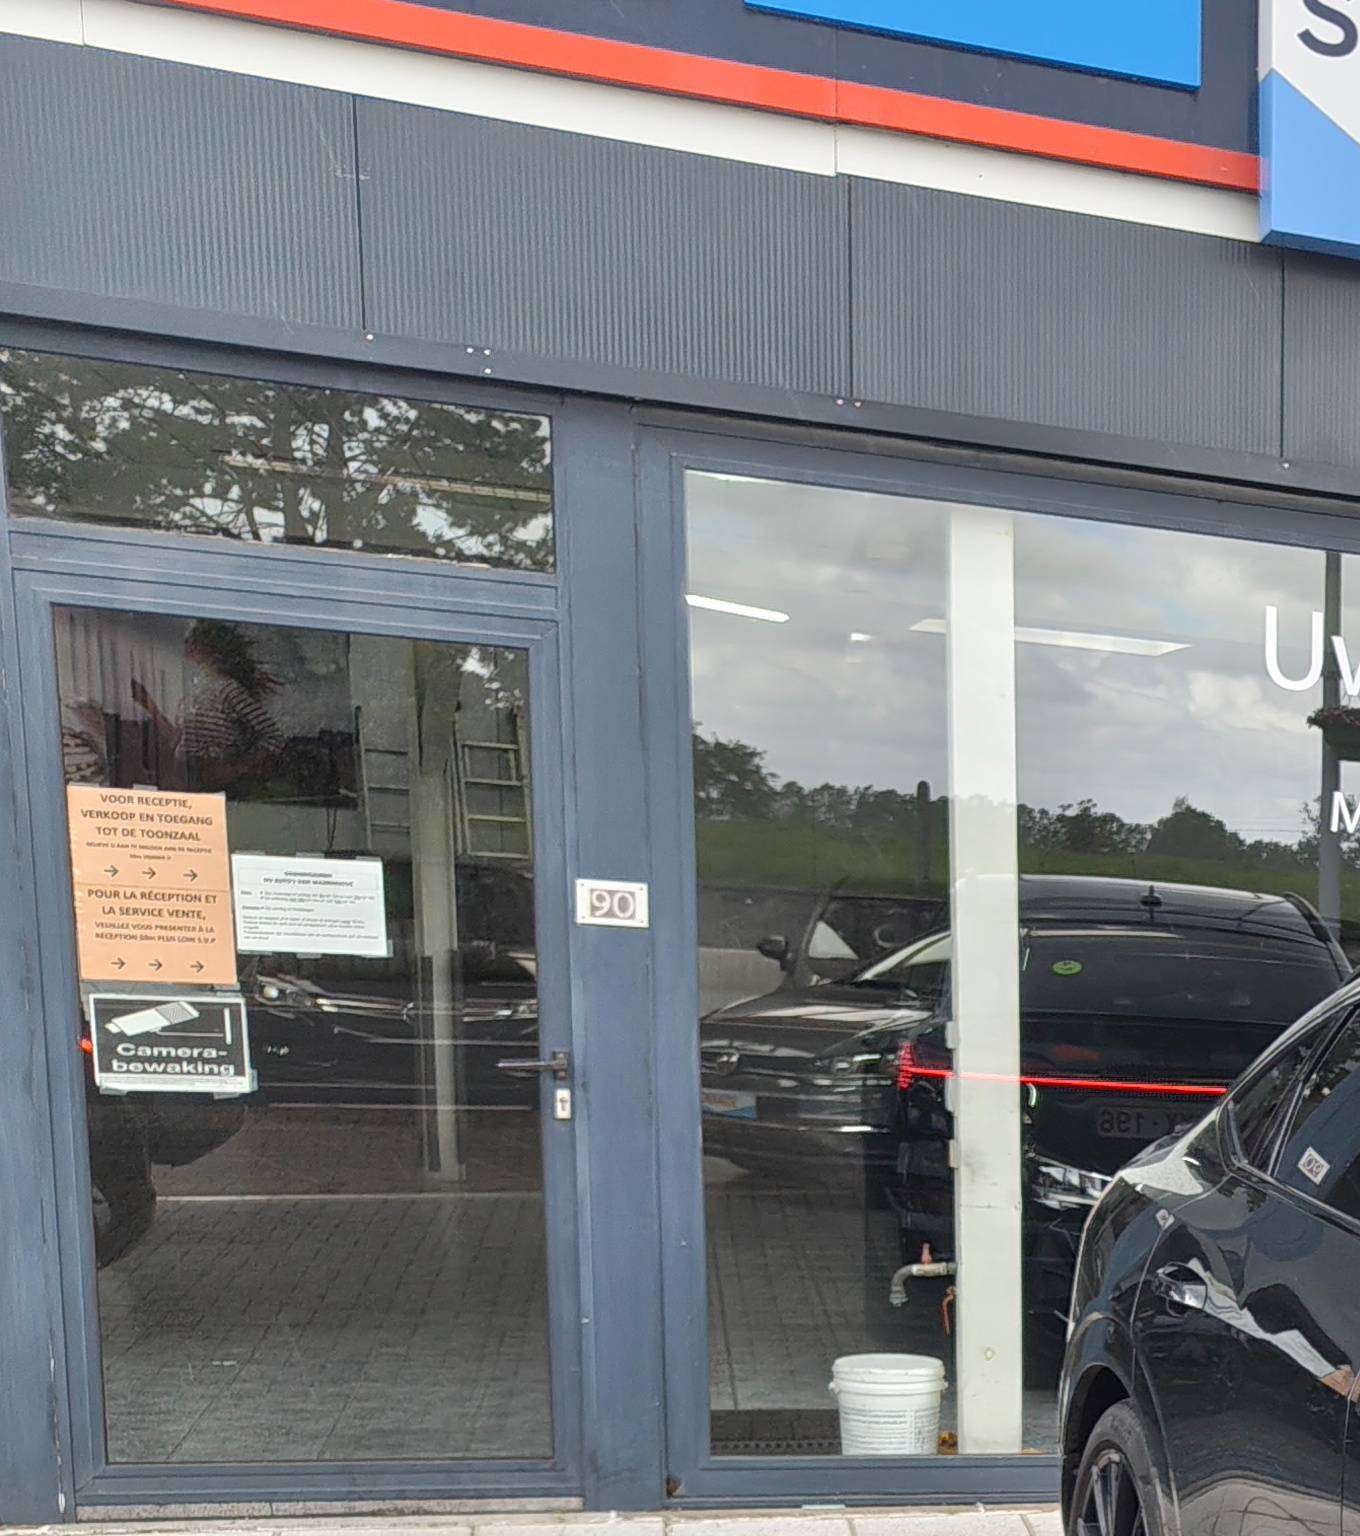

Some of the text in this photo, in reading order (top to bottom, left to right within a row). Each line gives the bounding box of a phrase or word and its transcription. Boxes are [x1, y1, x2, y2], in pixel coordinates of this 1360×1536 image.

[99, 793, 134, 804] VOOR
[80, 809, 213, 825] VERKOOP EN TOEGANG
[95, 826, 201, 841] TOT DE TOONZAAL
[88, 888, 120, 900] POUR
[123, 890, 138, 900] LA
[205, 894, 217, 904] ET
[591, 890, 635, 918] 90
[102, 905, 116, 915] LA
[119, 907, 165, 918] SERVICE
[116, 1042, 228, 1058] Camera-
[111, 1059, 235, 1076] bewaking
